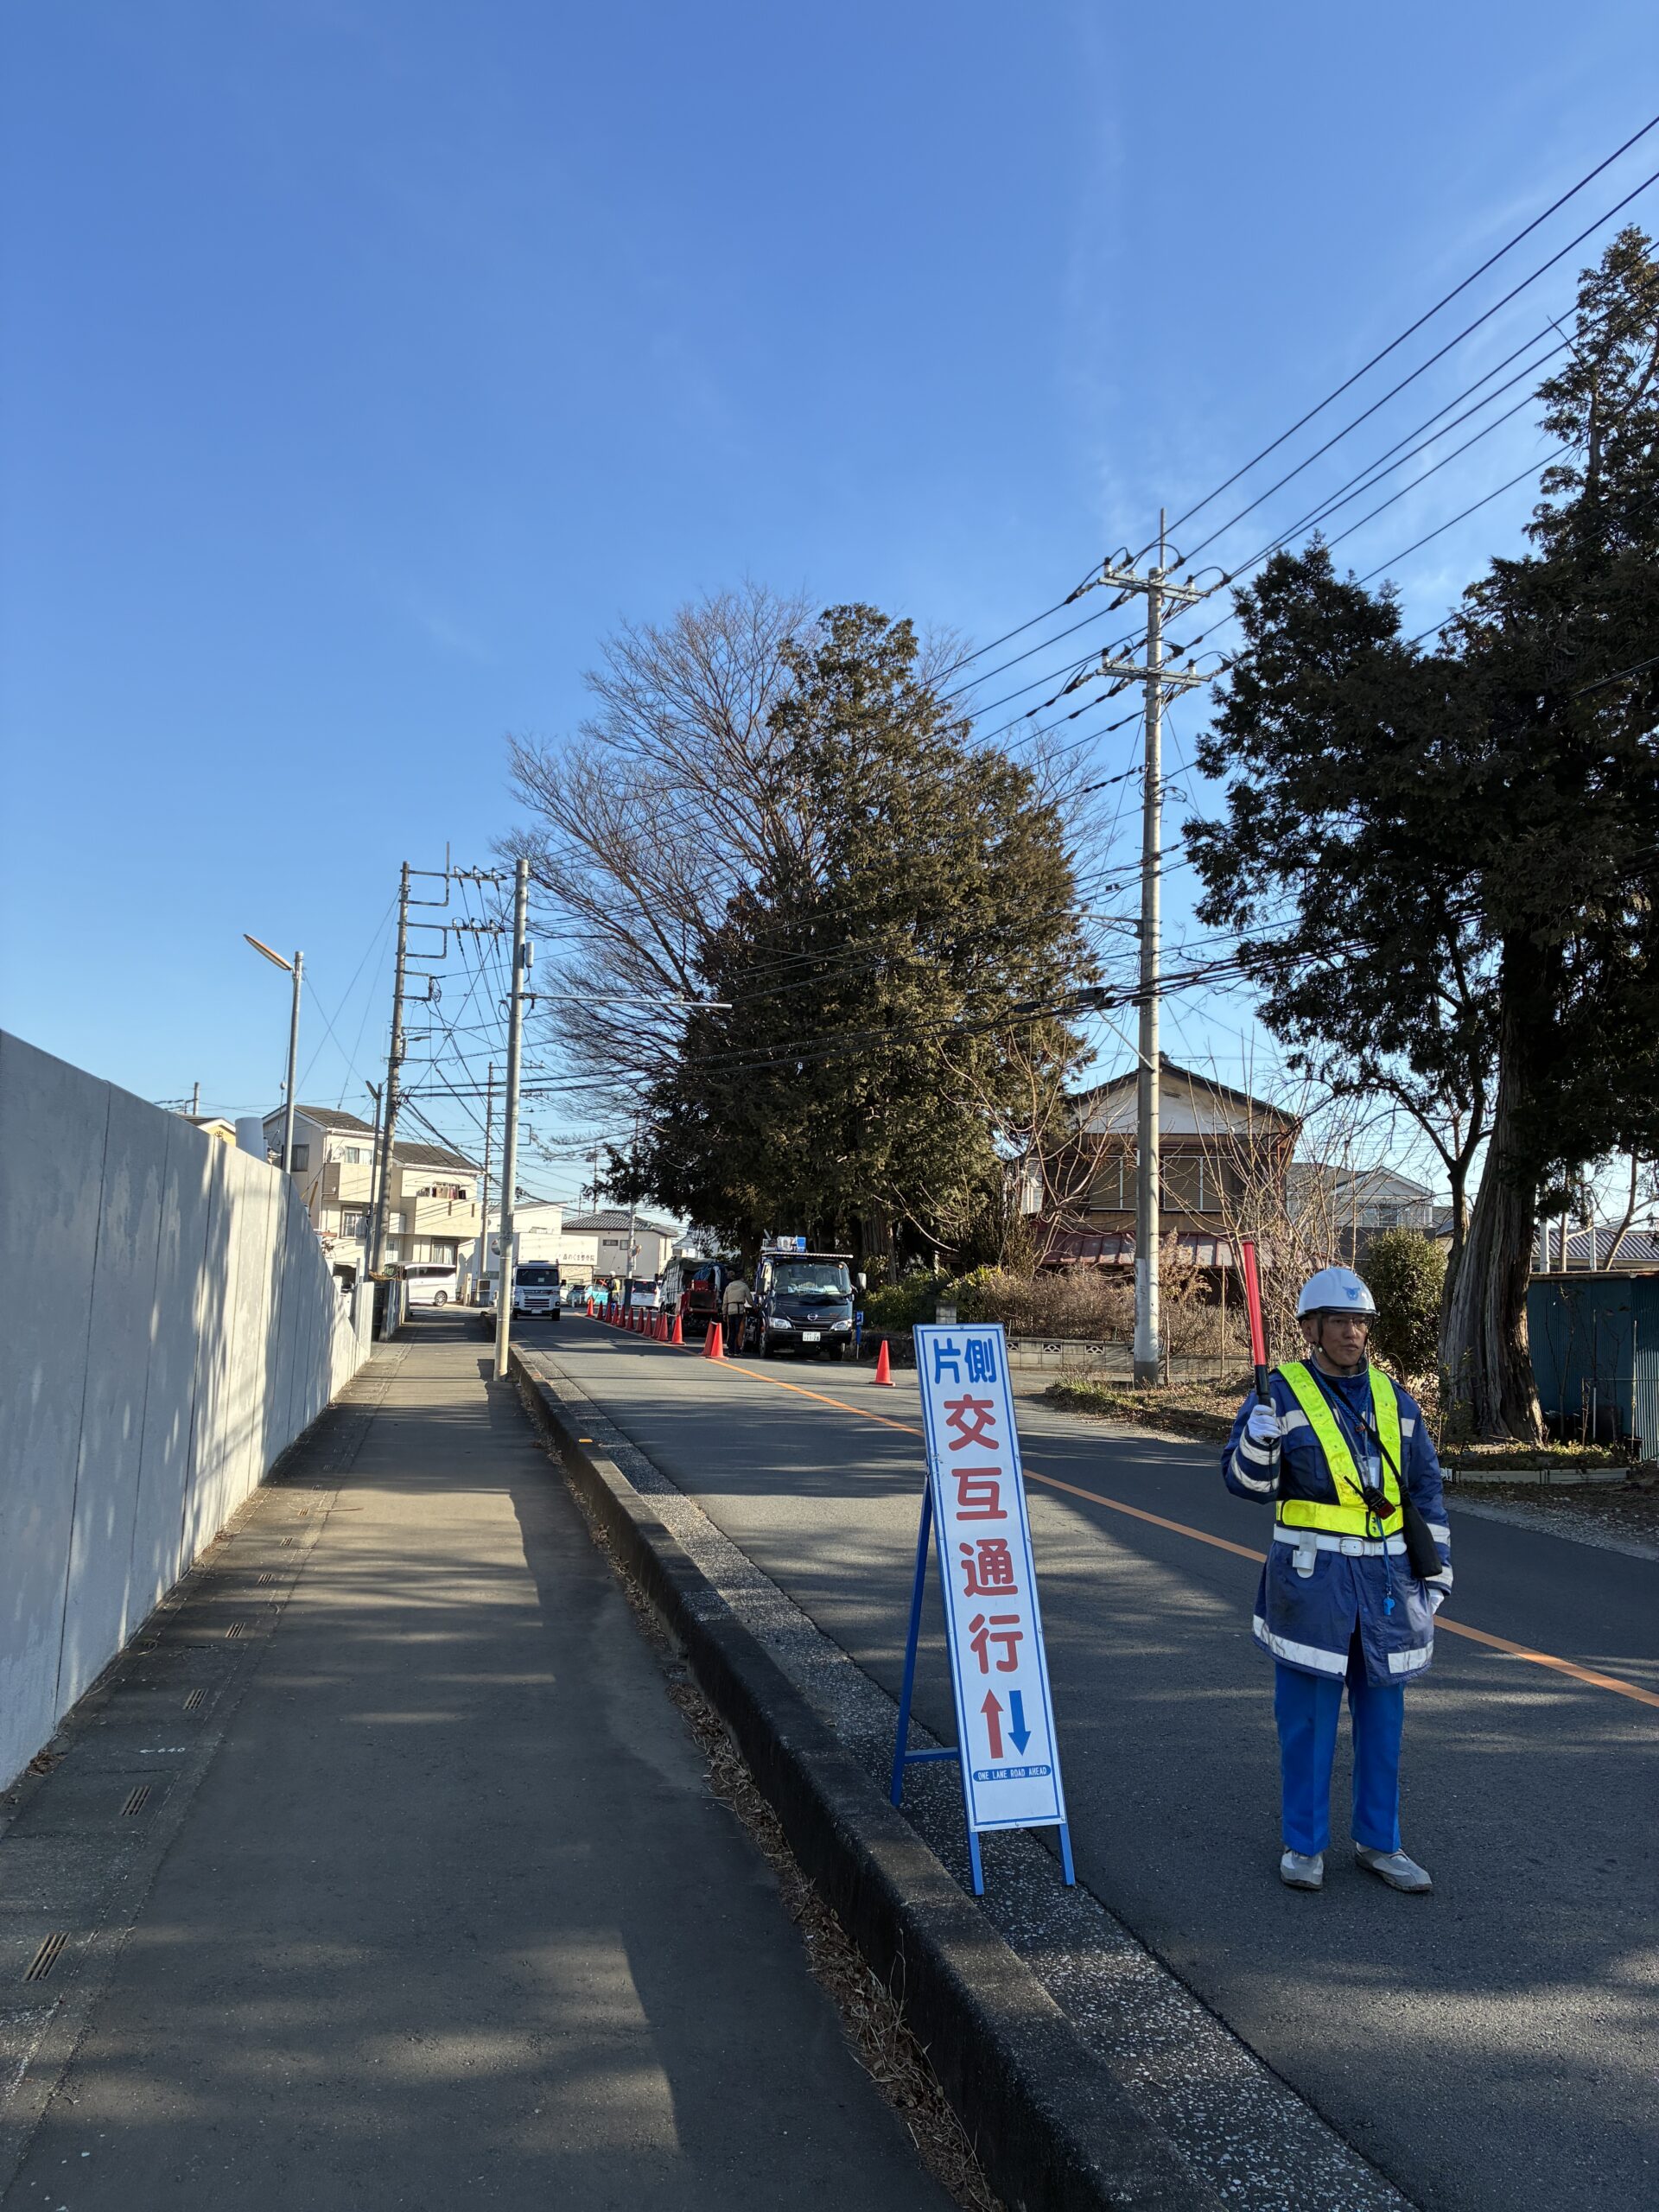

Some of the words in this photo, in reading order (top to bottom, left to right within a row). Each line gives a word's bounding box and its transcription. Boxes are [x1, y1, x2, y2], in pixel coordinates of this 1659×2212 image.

[933, 1338, 997, 1384] 片側
[944, 1394, 1023, 1675] 交互通行
[977, 1771, 989, 1781] ONE
[992, 1770, 1007, 1780] LANE
[1010, 1769, 1026, 1778] ROAD
[1028, 1766, 1047, 1777] AHEAD
